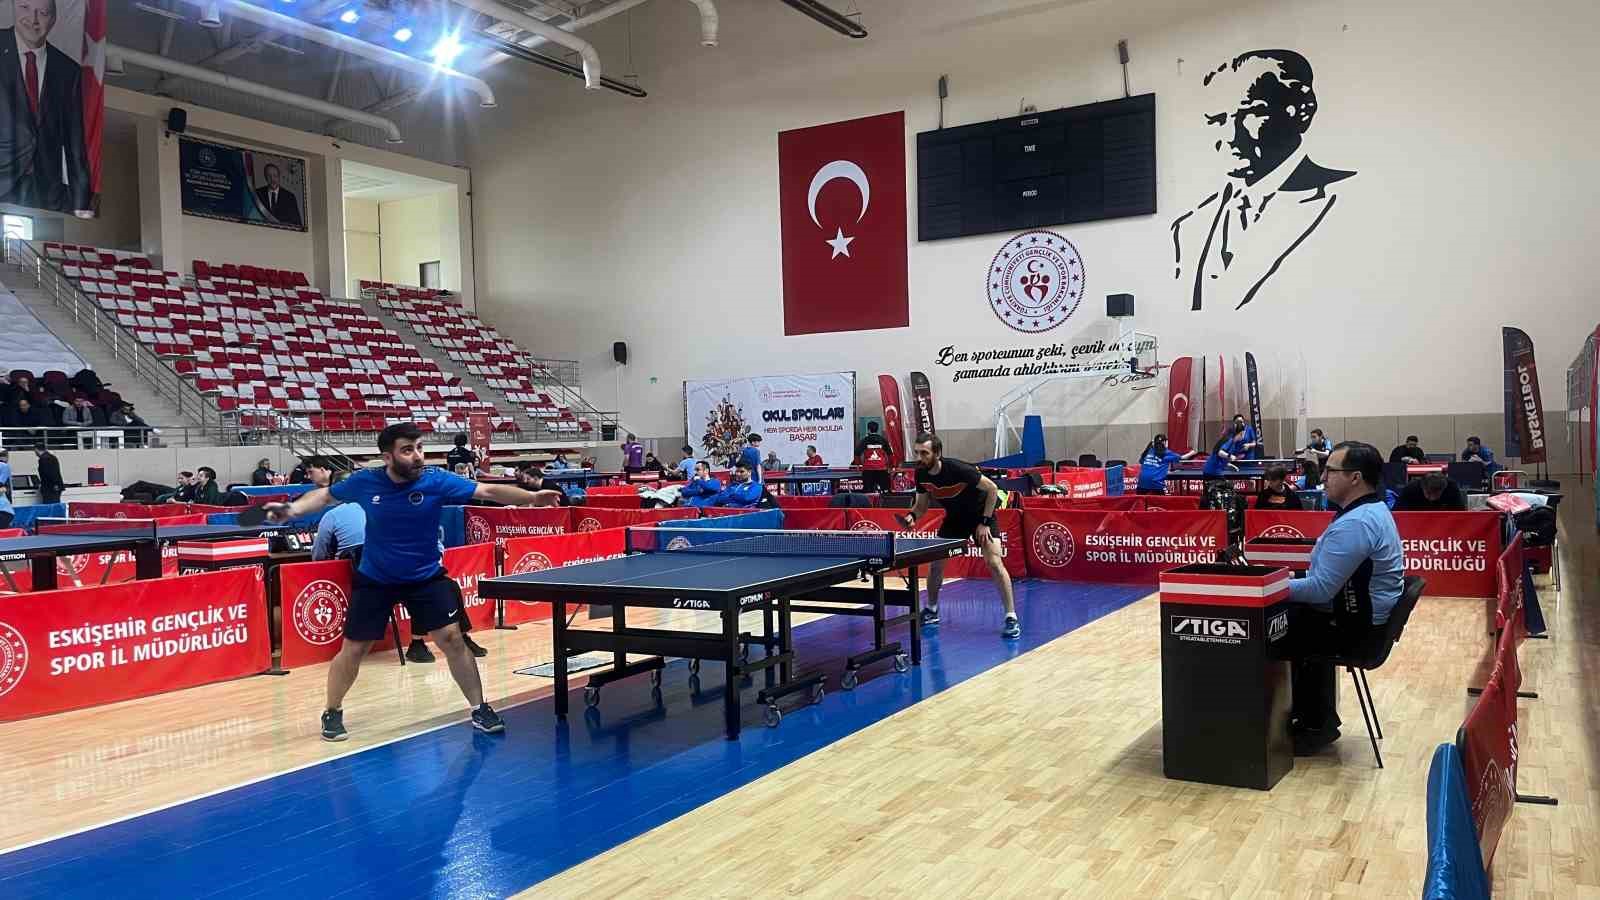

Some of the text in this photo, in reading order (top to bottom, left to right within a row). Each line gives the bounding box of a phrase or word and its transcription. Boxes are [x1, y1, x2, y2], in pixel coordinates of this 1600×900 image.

[1025, 249, 1053, 257] GENÇLİK
[935, 345, 968, 366] Ben
[971, 348, 1035, 364] sporcunun
[1035, 343, 1067, 360] zeki,
[1071, 340, 1106, 359] çevik
[952, 365, 1011, 383] zamanda
[762, 406, 845, 422] OKUL SPORLARI
[789, 433, 817, 442] BAŞARI
[495, 525, 528, 536] ESKİŞEHİR
[528, 525, 556, 537] GENÇLİK
[1085, 533, 1216, 550] ESKİŞEHİR GENÇLİK VE
[1401, 537, 1486, 555] GENÇLİK VE
[1086, 550, 1216, 564] SPOR İL MÜDÜRLÜĞÜ
[1402, 555, 1486, 571] ÜDÜRLÜĞÜ
[683, 599, 711, 608] STIGA
[740, 593, 764, 606] OPTIMUM
[49, 603, 248, 649] ESKİŞEHİR GENÇLİK VE
[1174, 619, 1246, 636] STIGA
[1268, 613, 1288, 638] STIGA
[1180, 636, 1241, 645] STIGATABLETENNIS.COM
[50, 624, 248, 676] SPOR İL MÜDÜRLÜĞÜ
